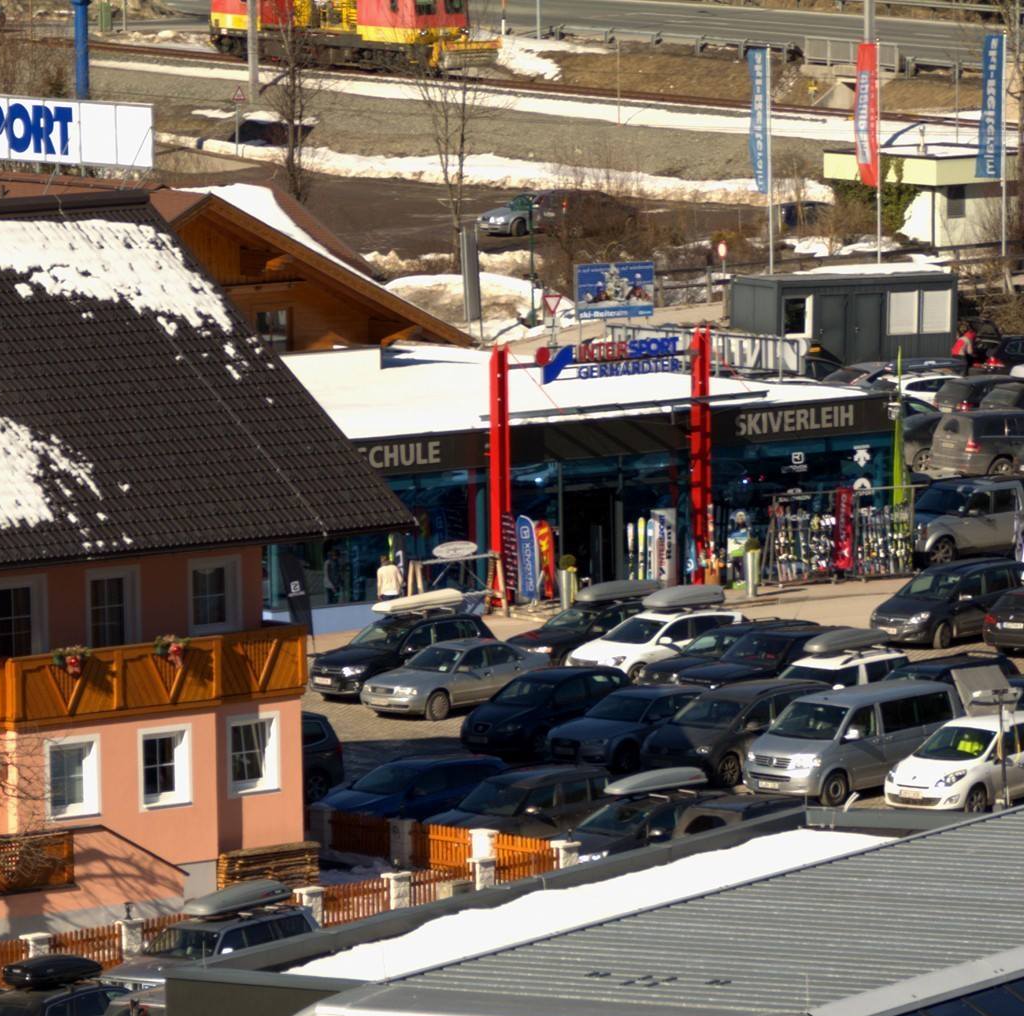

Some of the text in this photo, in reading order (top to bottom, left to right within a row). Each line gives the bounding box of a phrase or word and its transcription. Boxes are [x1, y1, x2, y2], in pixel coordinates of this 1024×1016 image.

[578, 336, 680, 362] INTERSPORT
[578, 358, 681, 379] GERHARDTER
[735, 404, 854, 436] SKIVERLEIH
[358, 441, 441, 468] CHULE
